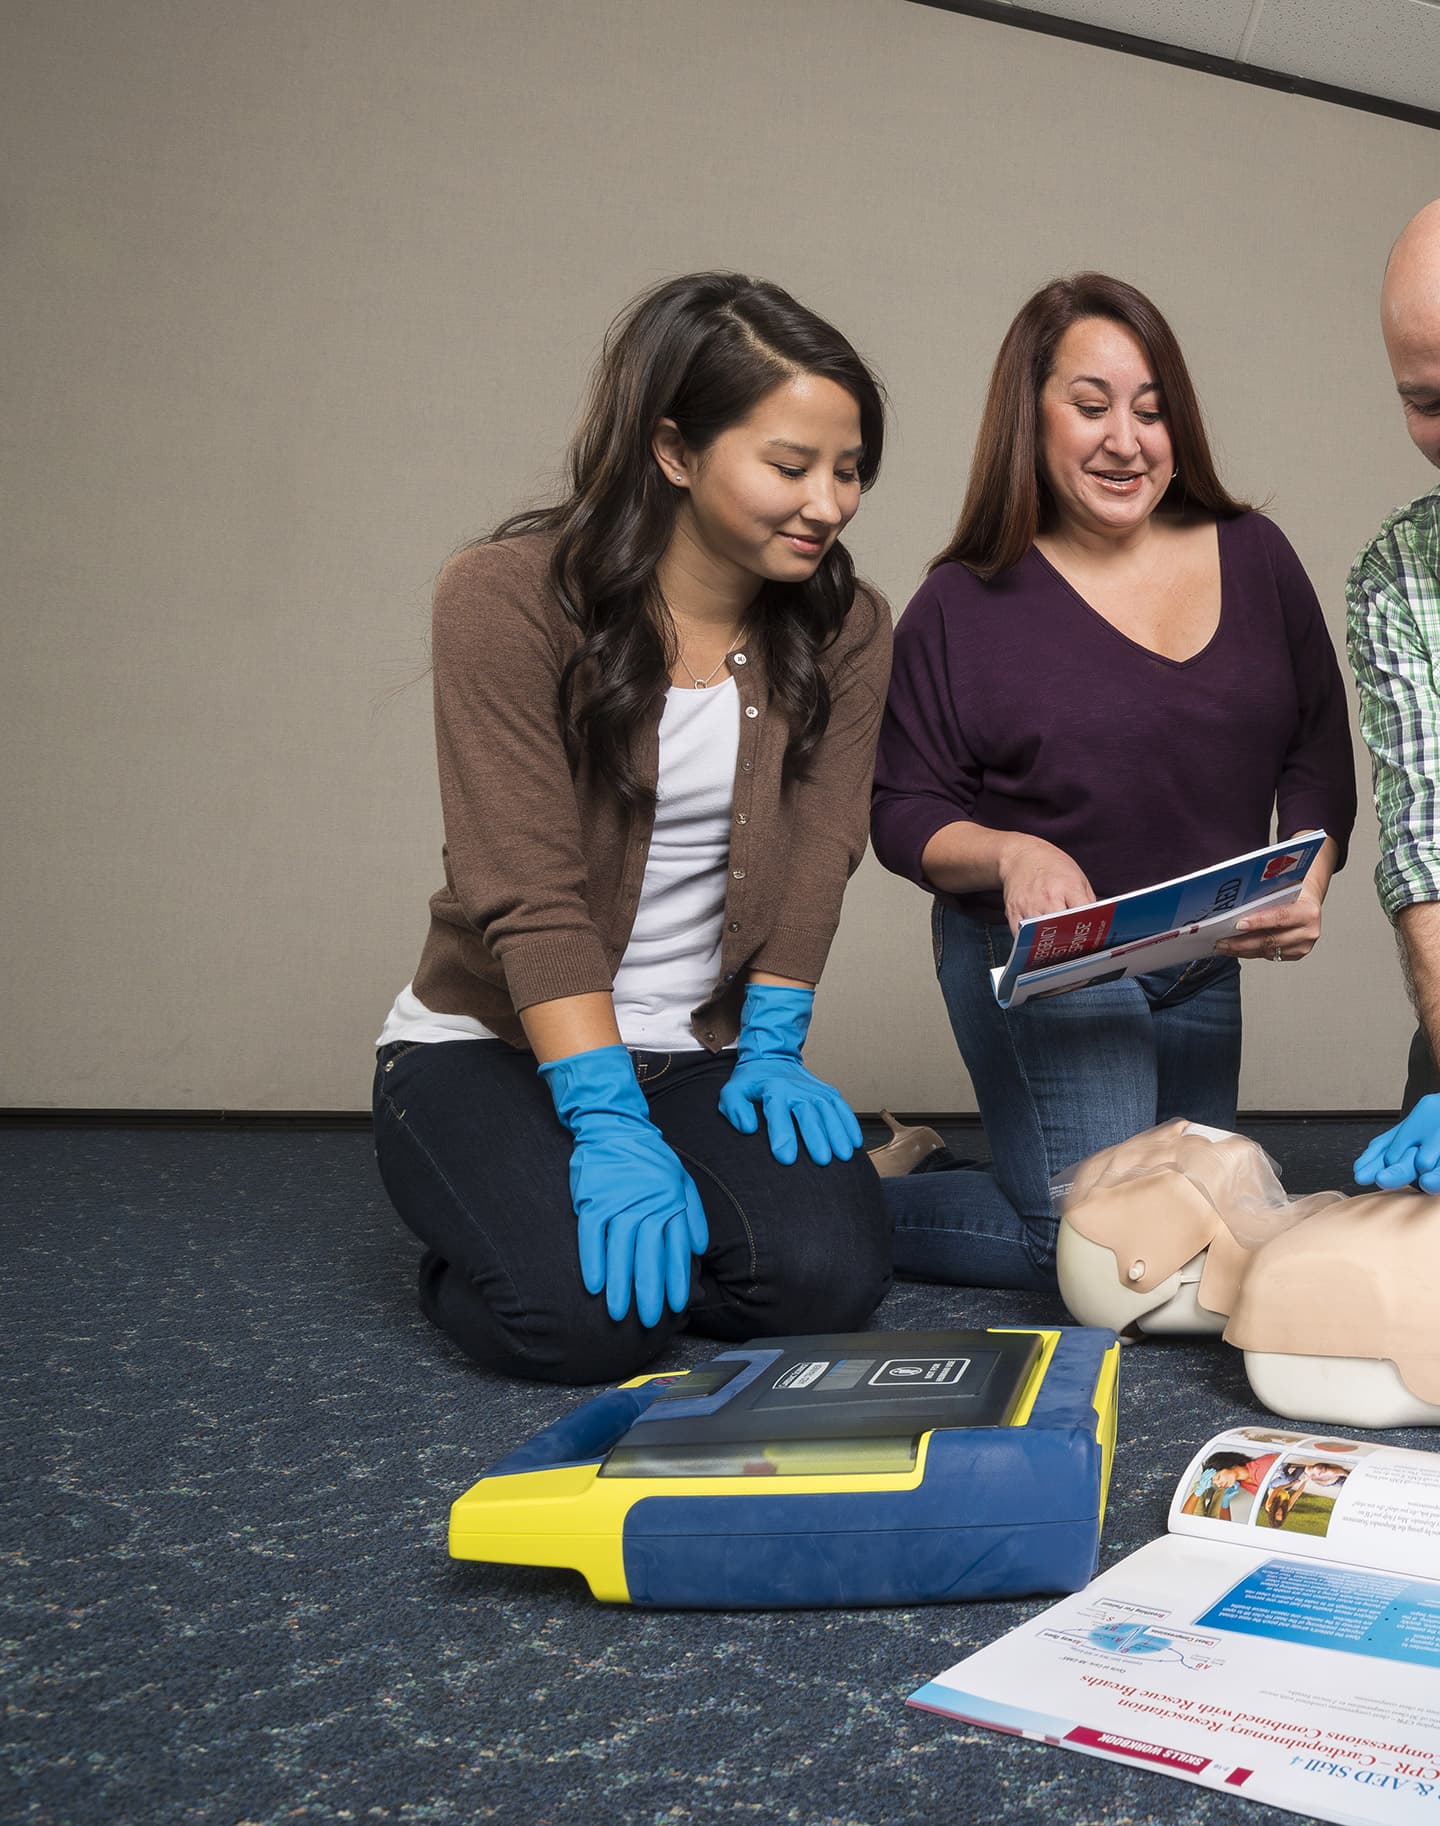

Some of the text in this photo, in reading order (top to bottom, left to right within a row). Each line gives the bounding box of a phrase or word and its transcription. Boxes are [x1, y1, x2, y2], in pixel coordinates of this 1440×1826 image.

[1079, 1674, 1138, 1698] Breaths
[1138, 1689, 1194, 1711] Rescue
[1117, 1699, 1223, 1734] Resuscitation
[1198, 1703, 1234, 1723] with
[1231, 1712, 1323, 1739] Combined
[1096, 1733, 1205, 1767] SKILLS WORKBOOK
[1222, 1722, 1377, 1768] Cardiopulmonary
[1303, 1757, 1352, 1779] Skill
[1394, 1761, 1440, 1779] CPR
[1354, 1769, 1409, 1792] AED
[1413, 1782, 1435, 1798] &
